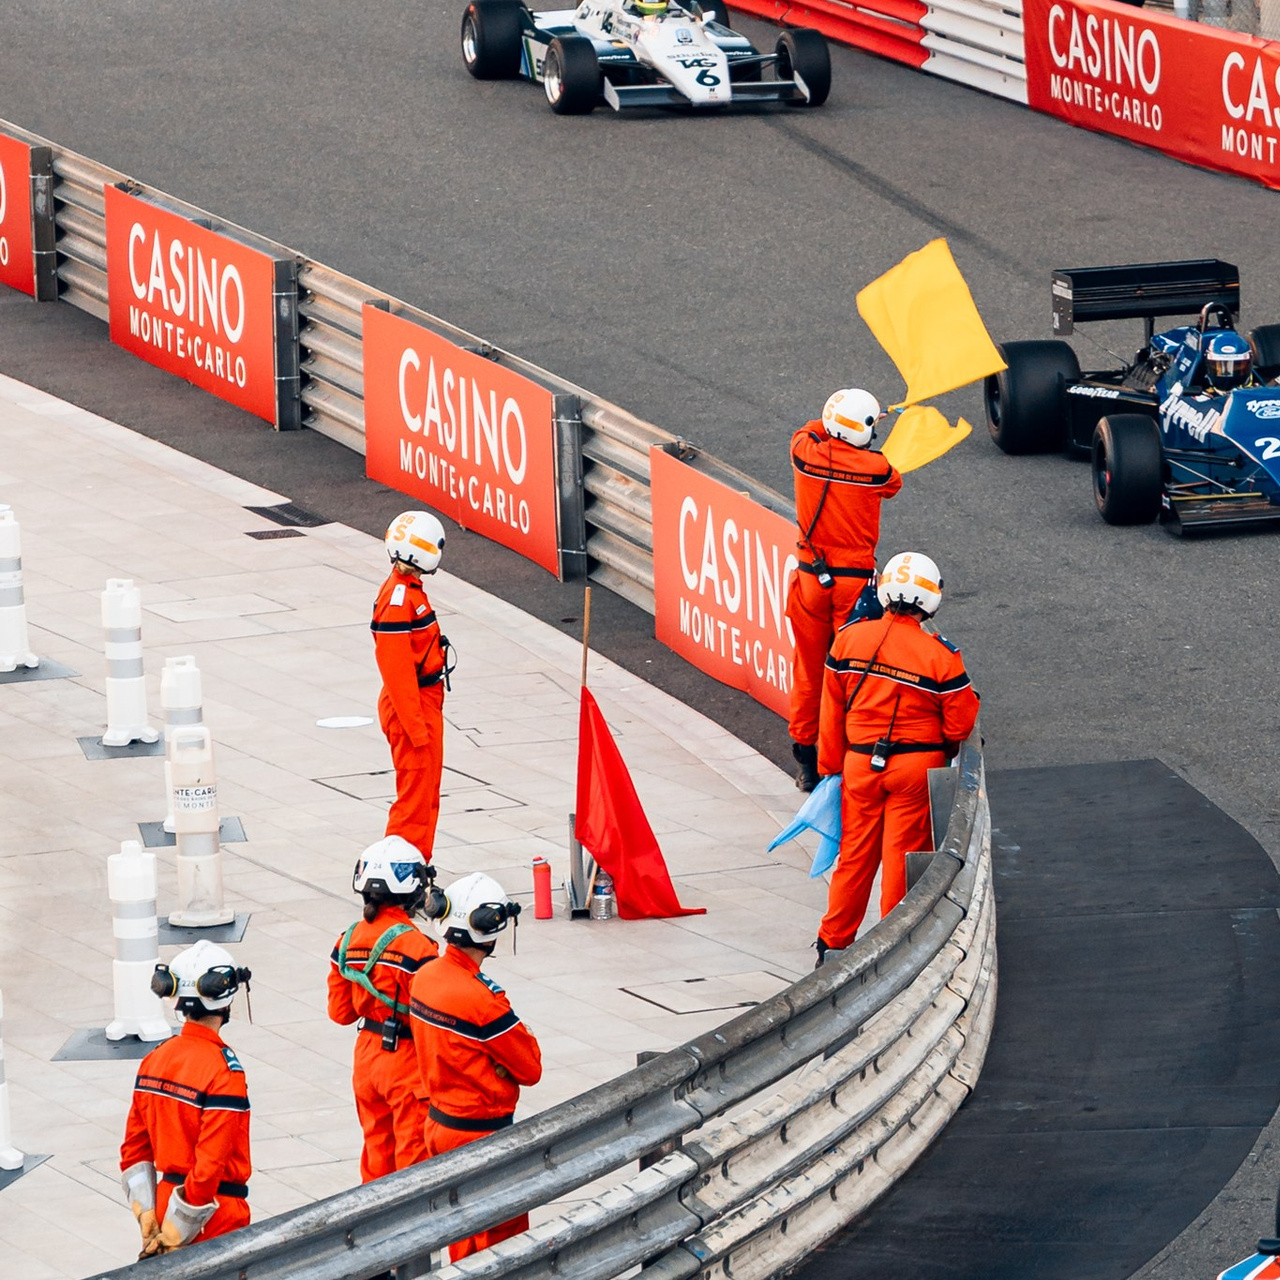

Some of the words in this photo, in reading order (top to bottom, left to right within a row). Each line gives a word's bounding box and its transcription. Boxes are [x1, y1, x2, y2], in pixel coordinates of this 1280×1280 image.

[675, 57, 718, 70] TAG
[695, 69, 721, 87] 6
[1049, 5, 1160, 96] CASINO
[1051, 74, 1102, 112] MONTE
[1112, 93, 1161, 130] CARLO
[129, 223, 245, 344] CASINO
[130, 306, 185, 357] MONTE
[194, 337, 245, 387] CARLO
[399, 348, 527, 486] CASINO
[1159, 382, 1221, 444] Tyrrell
[400, 439, 456, 498] MONTE
[469, 476, 529, 534] CARLO
[393, 524, 408, 542] S
[895, 565, 910, 584] S
[679, 597, 743, 665] MONTE
[753, 639, 794, 695] CAR
